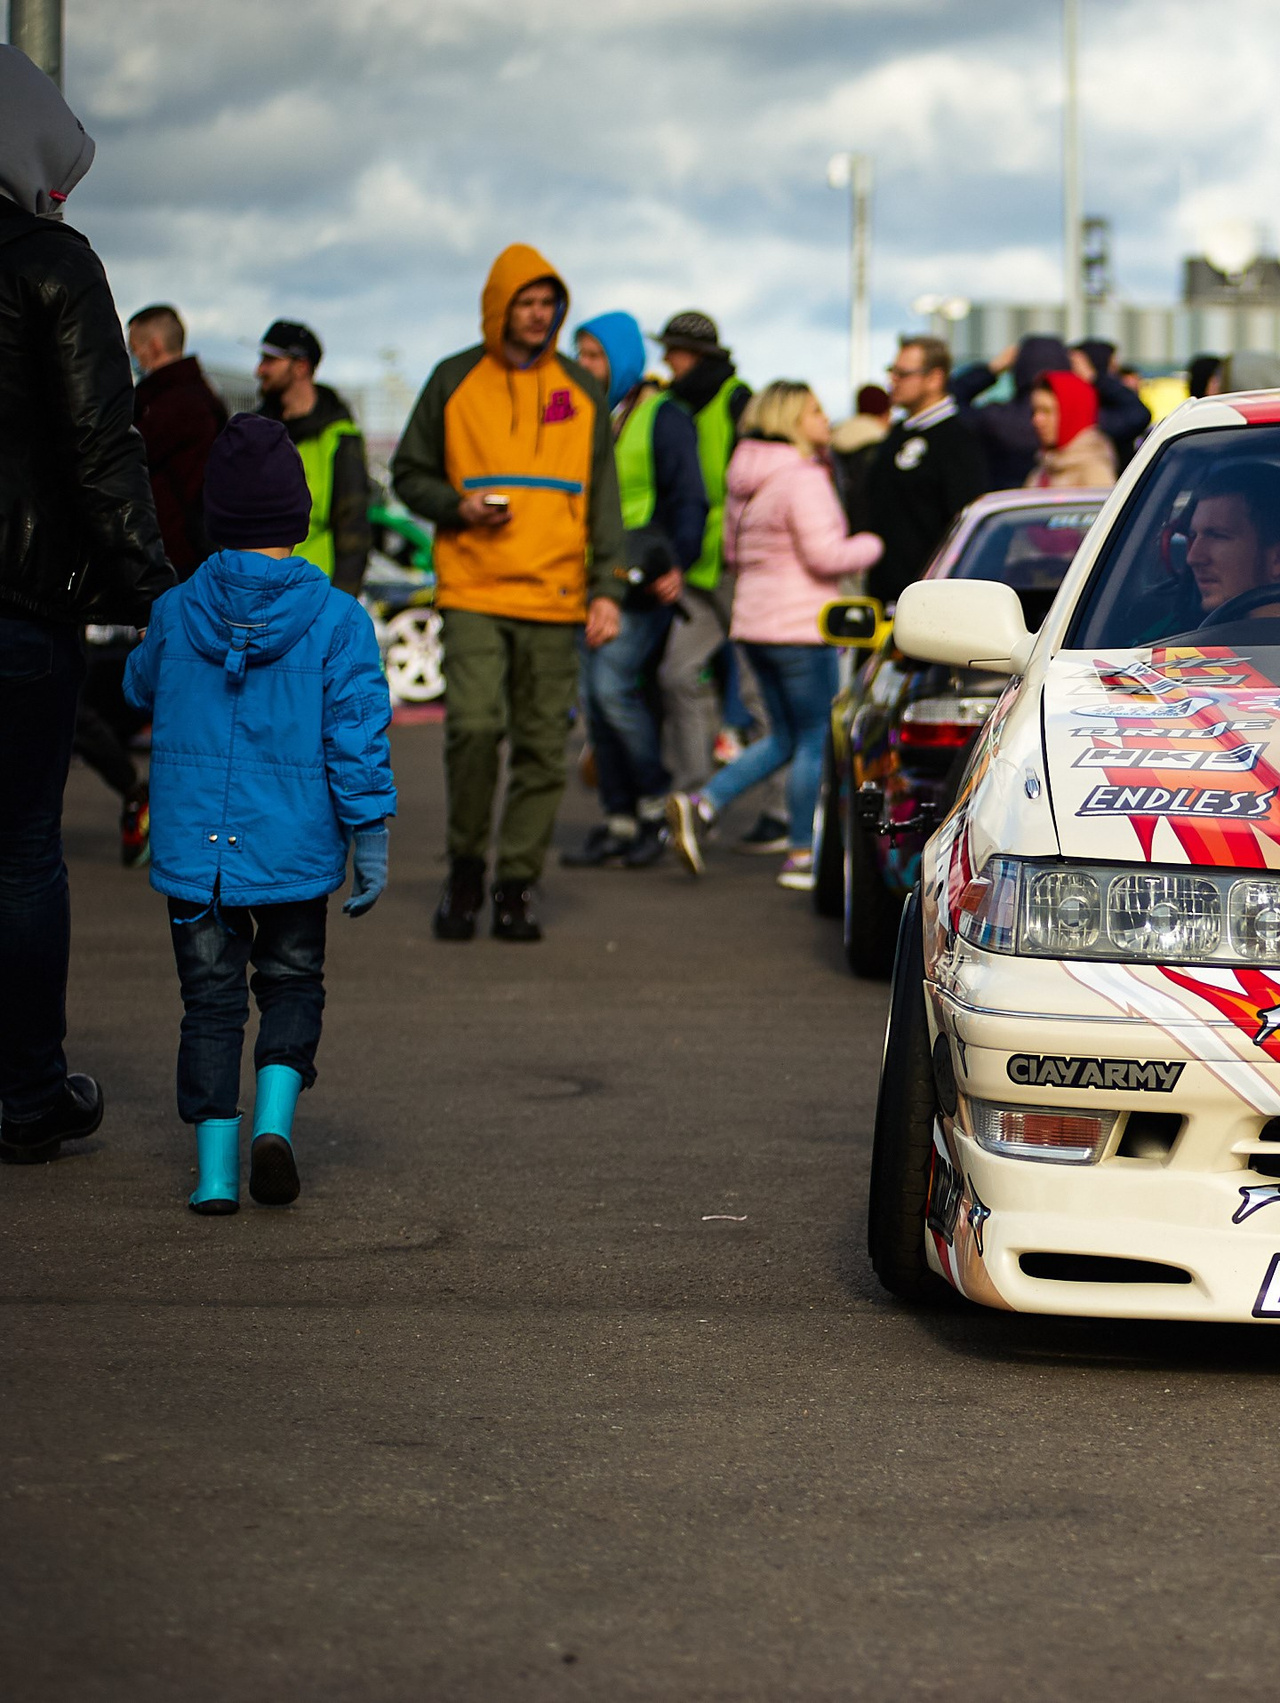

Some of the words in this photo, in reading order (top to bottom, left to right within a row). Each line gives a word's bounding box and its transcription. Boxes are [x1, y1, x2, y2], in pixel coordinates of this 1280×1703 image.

[1072, 719, 1276, 739] BRIDE
[1076, 744, 1265, 770] HKS
[1085, 785, 1279, 816] ENDLESS
